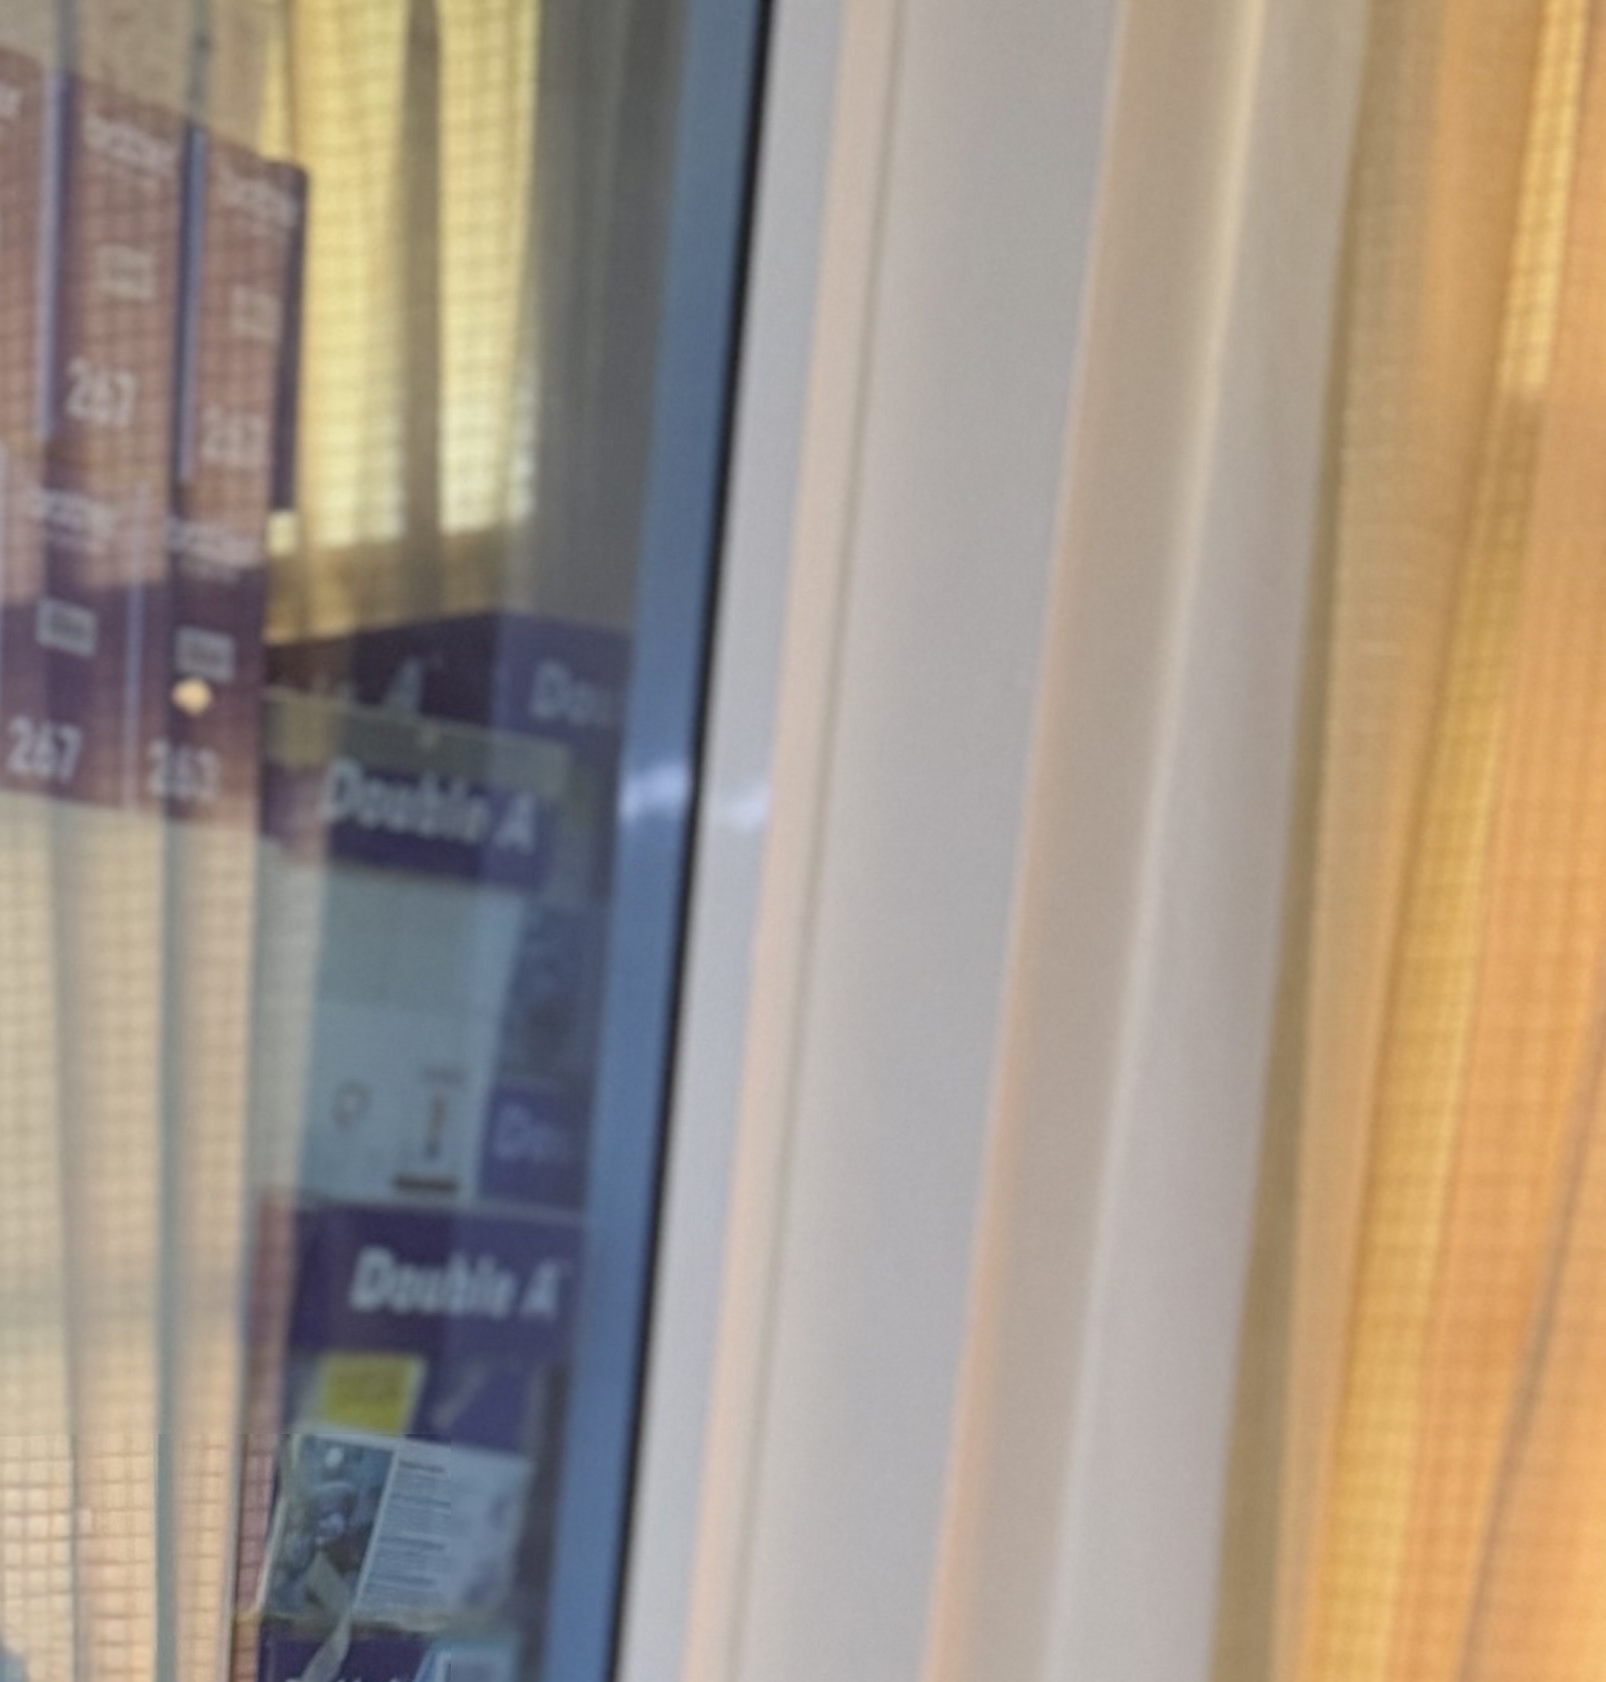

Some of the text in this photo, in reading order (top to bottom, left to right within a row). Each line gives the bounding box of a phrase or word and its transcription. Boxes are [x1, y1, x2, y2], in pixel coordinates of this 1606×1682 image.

[6, 715, 82, 784] 267
[348, 1243, 562, 1322] Double A
